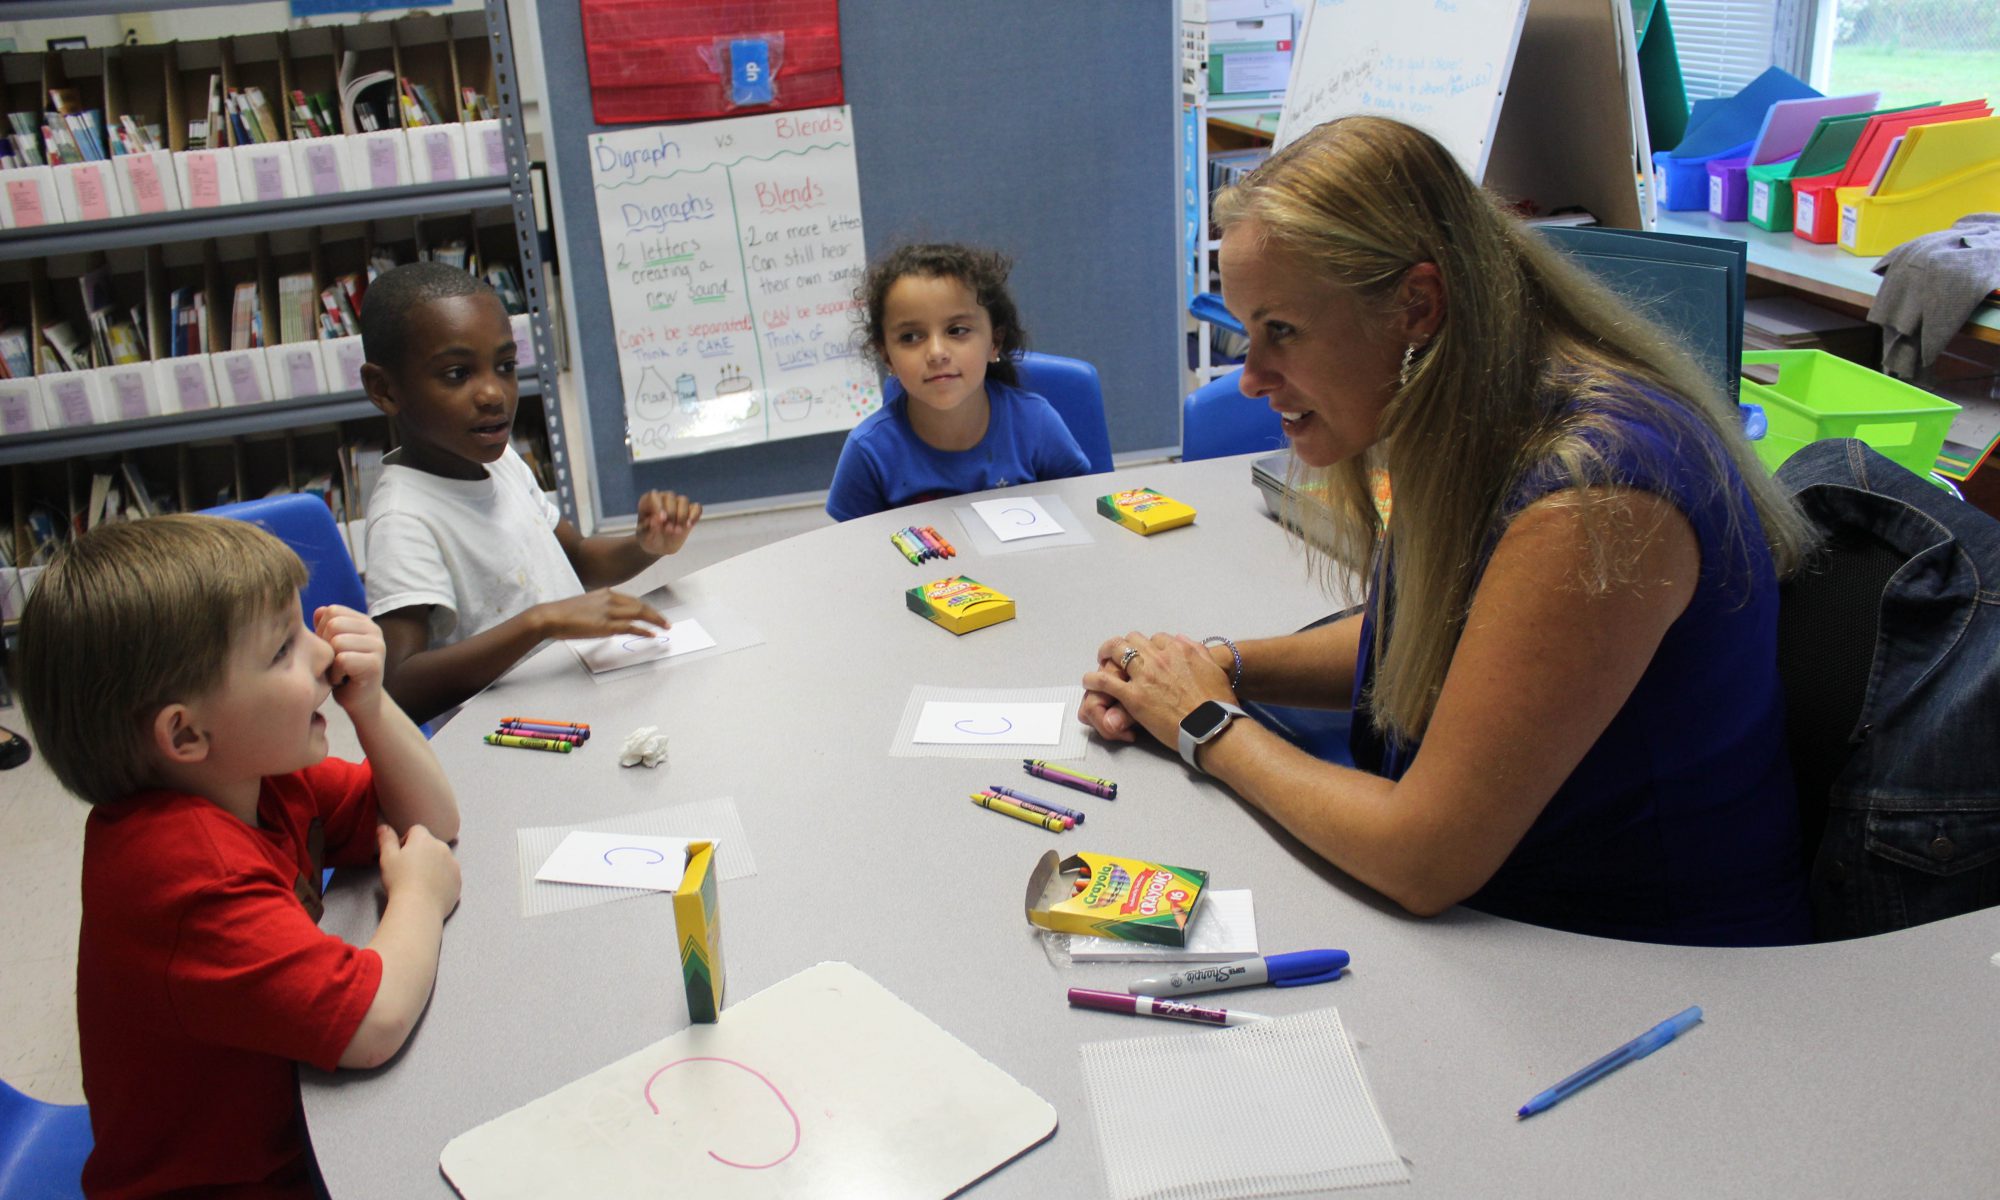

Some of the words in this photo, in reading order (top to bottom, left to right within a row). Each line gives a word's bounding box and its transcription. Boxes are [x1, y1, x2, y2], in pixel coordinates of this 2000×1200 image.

[595, 132, 681, 179] Digraph
[774, 117, 844, 139] Blends
[755, 177, 824, 208] Blends
[621, 194, 714, 233] Digraphs
[766, 230, 779, 243] or
[787, 224, 820, 239] more
[617, 243, 630, 268] 2
[641, 237, 701, 262] letters
[785, 244, 815, 267] still
[822, 242, 850, 258] hear
[632, 265, 692, 286] creating
[699, 260, 714, 272] a
[760, 277, 790, 295] their
[796, 272, 822, 288] own
[646, 290, 677, 307] new
[688, 278, 734, 299] sound
[664, 324, 681, 341] be
[764, 328, 805, 349] Think
[809, 323, 823, 340] of
[633, 346, 670, 359] Think
[675, 342, 688, 356] of
[697, 336, 734, 353] CAKE
[604, 846, 664, 865] C
[1084, 865, 1112, 905] Crayola
[1140, 871, 1174, 915] CRAYONS
[1171, 891, 1185, 901] 16
[1184, 966, 1231, 983] Sharpie
[1228, 966, 1246, 976] SUPER
